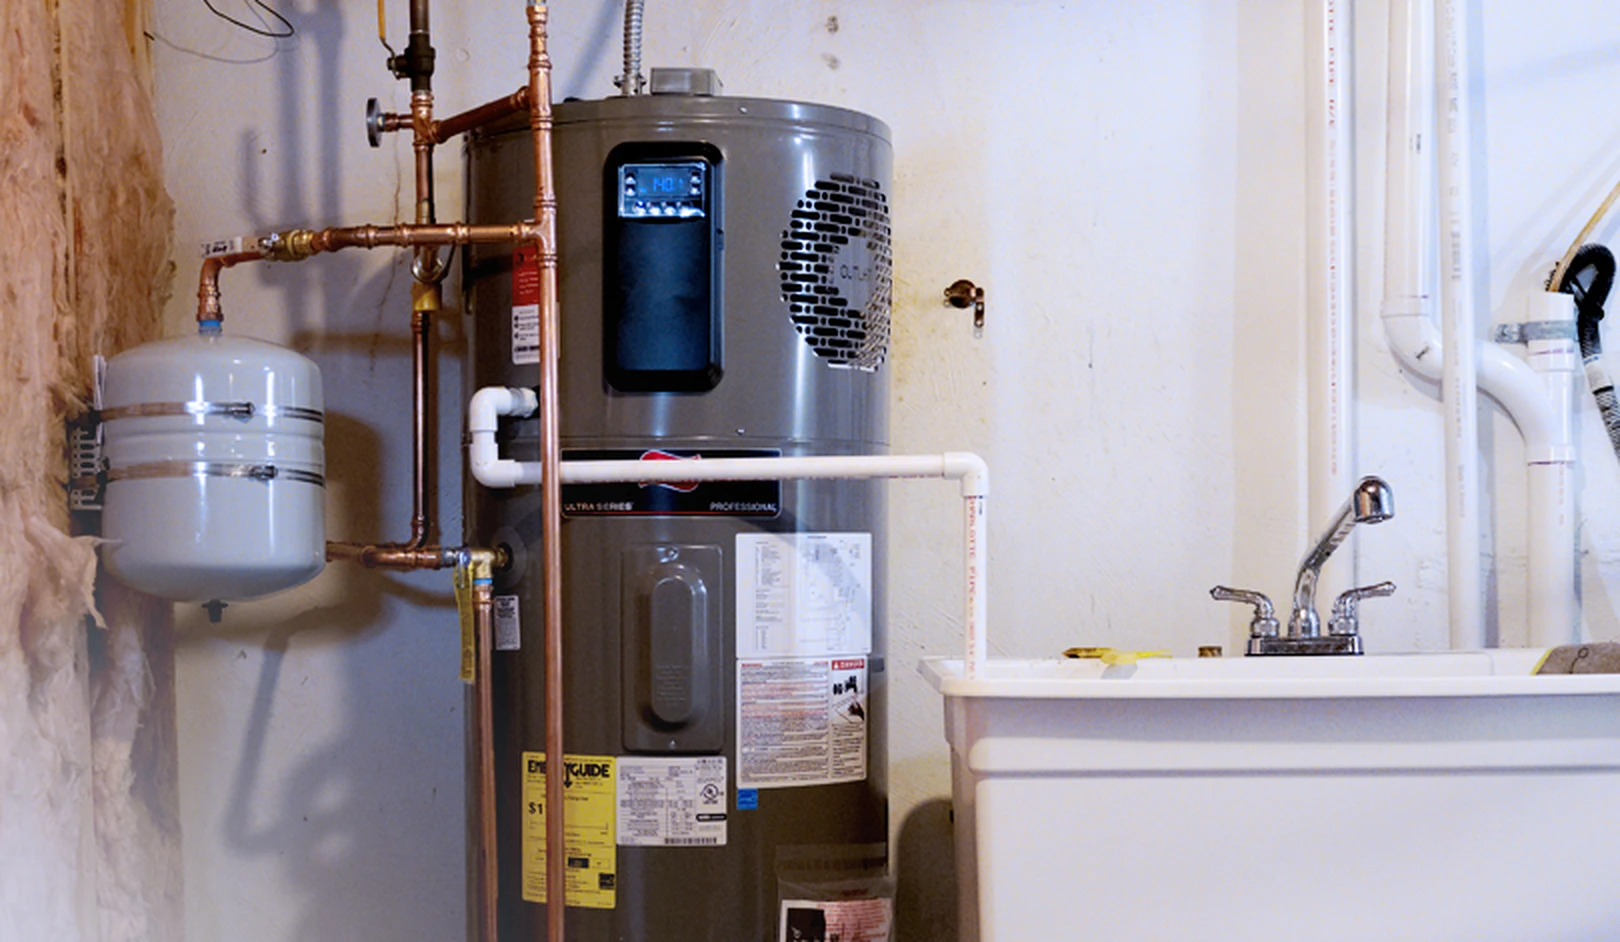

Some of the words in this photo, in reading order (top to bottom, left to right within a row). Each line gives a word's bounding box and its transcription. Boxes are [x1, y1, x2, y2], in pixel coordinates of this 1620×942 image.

[564, 502, 595, 511] ULTRA
[596, 501, 632, 511] SERIES
[709, 501, 777, 513] PROFESSIONAL
